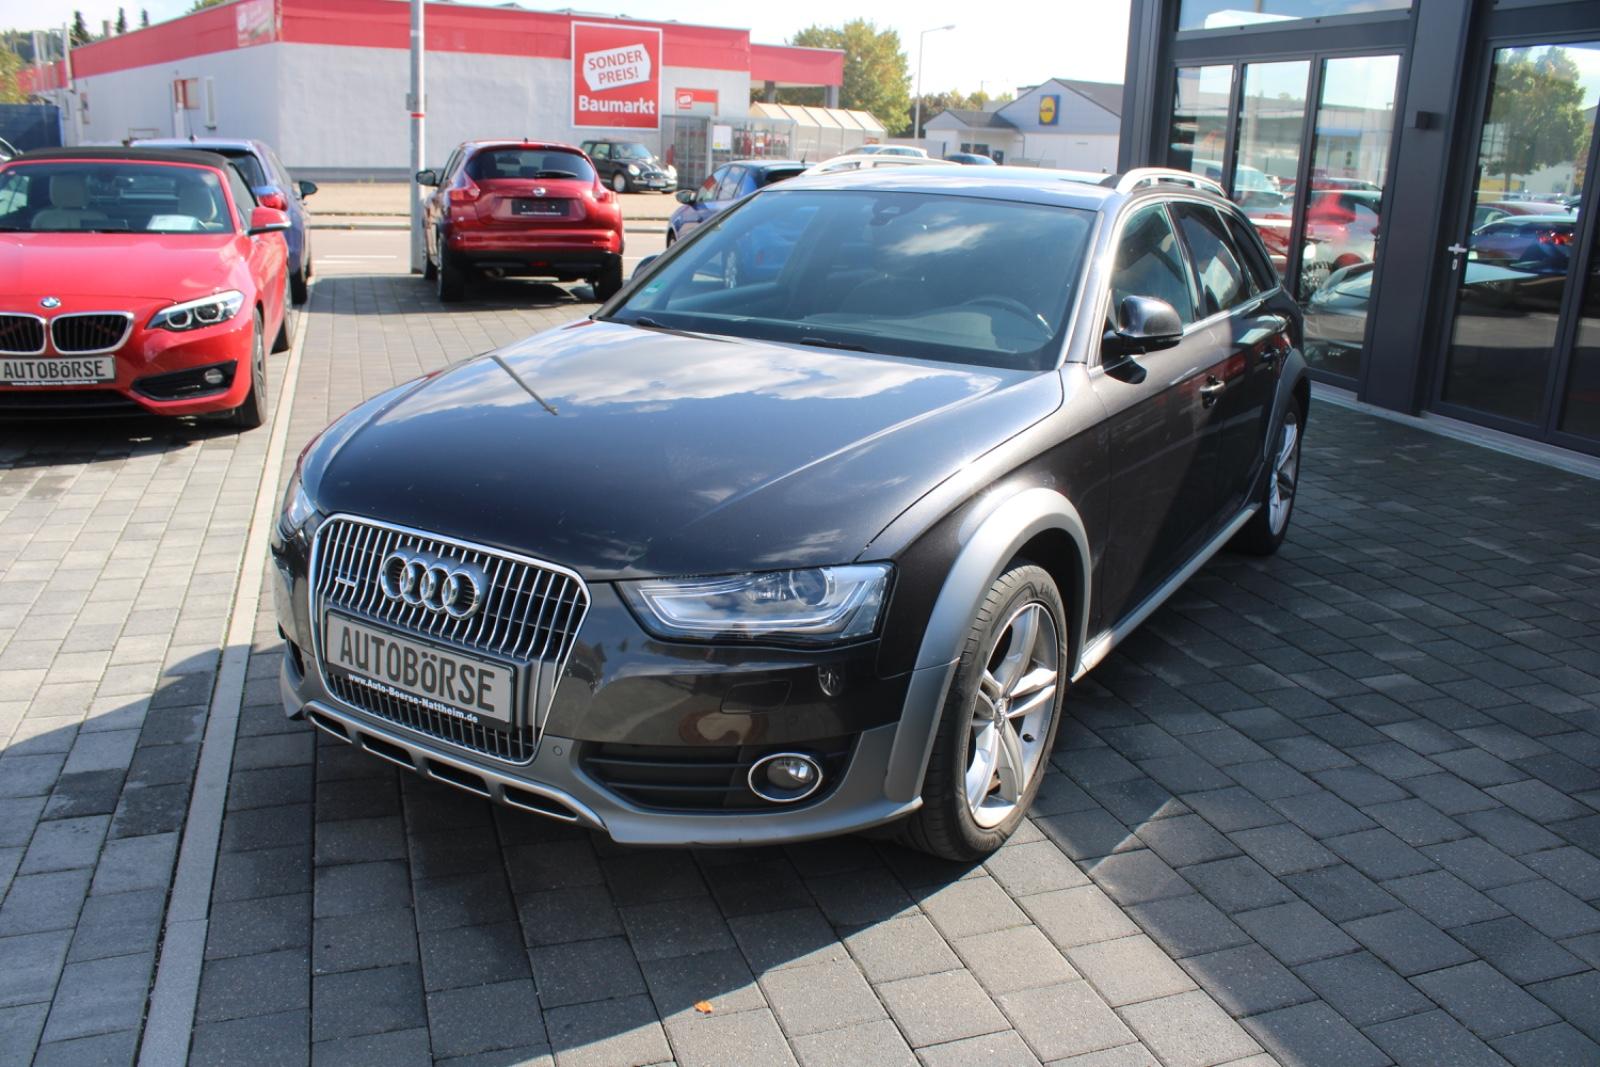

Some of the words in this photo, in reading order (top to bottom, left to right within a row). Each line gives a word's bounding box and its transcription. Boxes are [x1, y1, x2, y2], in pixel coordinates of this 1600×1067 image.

[588, 50, 643, 71] SONDER
[598, 66, 639, 84] PREIS!
[578, 95, 655, 115] Baumarkt
